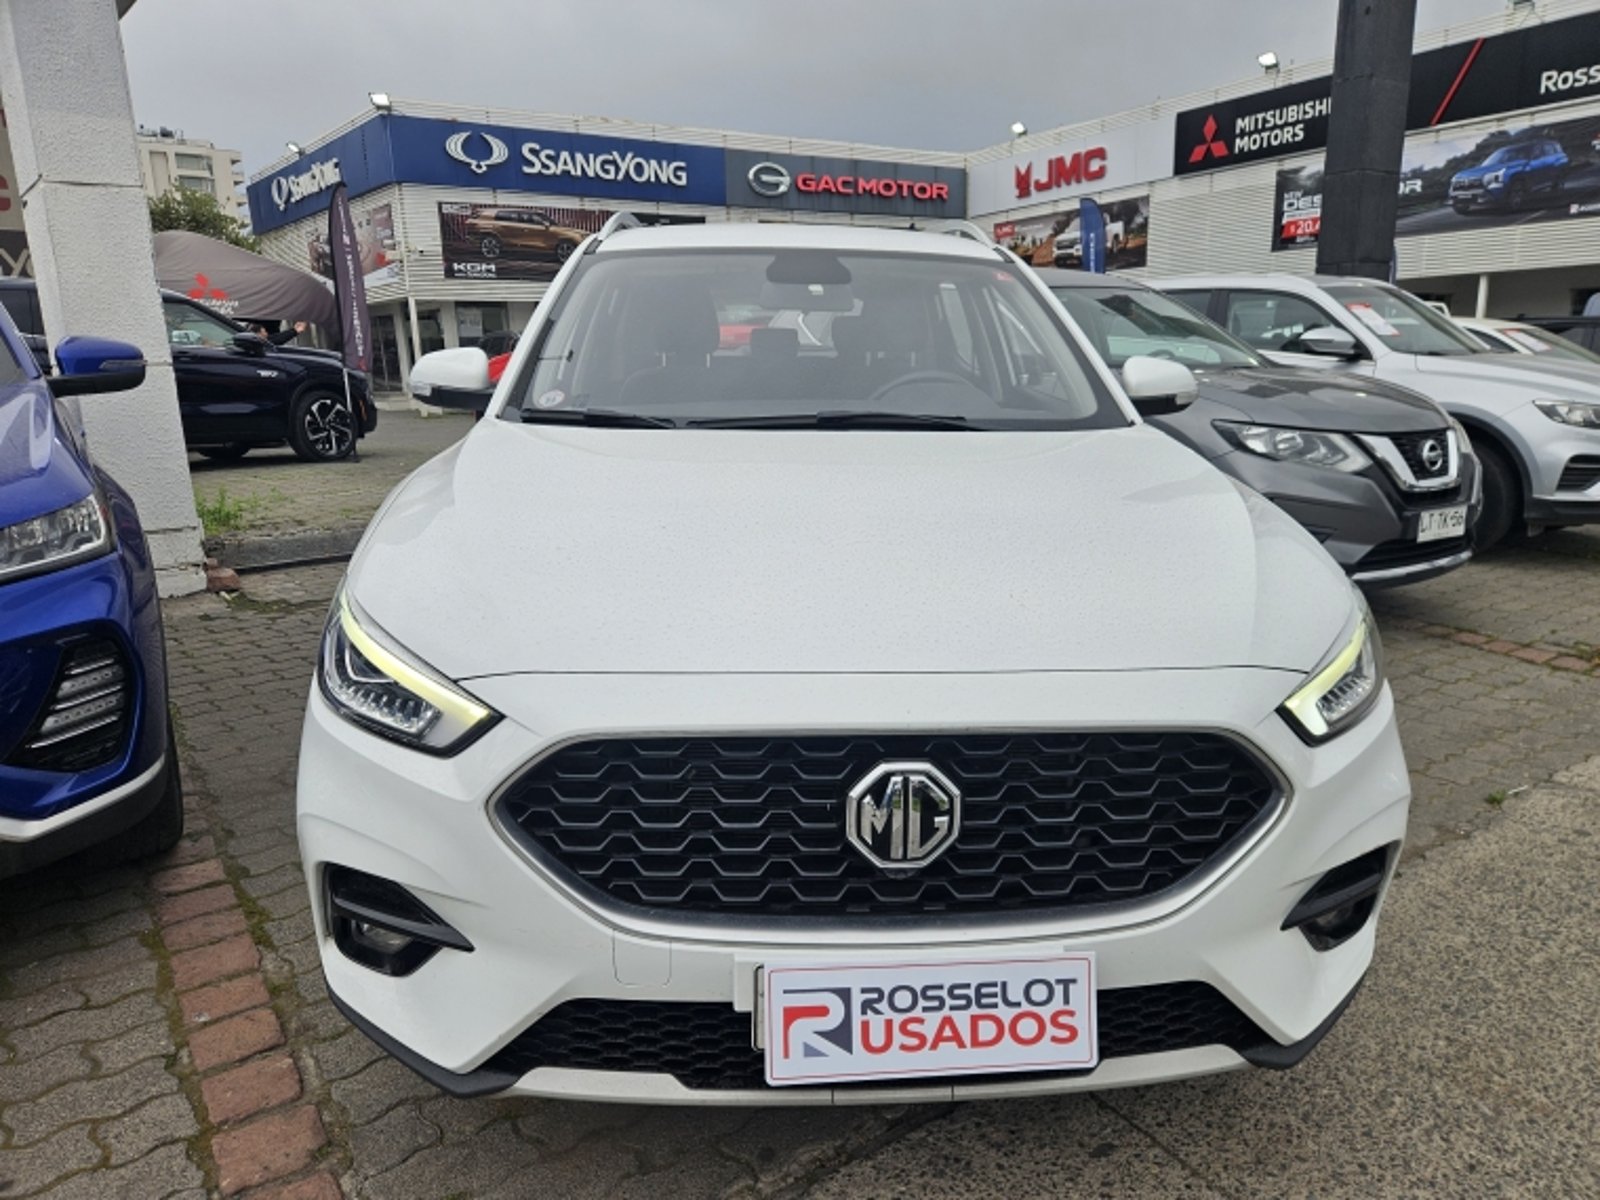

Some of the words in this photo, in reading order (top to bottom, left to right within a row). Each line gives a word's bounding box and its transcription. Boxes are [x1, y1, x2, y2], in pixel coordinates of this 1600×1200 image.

[1235, 97, 1332, 135] MITSUBISHI
[1234, 123, 1305, 154] MOTORS
[796, 173, 854, 194] GAC
[858, 177, 948, 200] MOTOR
[1034, 147, 1108, 192] JMC
[860, 775, 950, 860] MG
[859, 978, 1078, 1016] ROSSELOT
[859, 1008, 1080, 1055] USADOS
